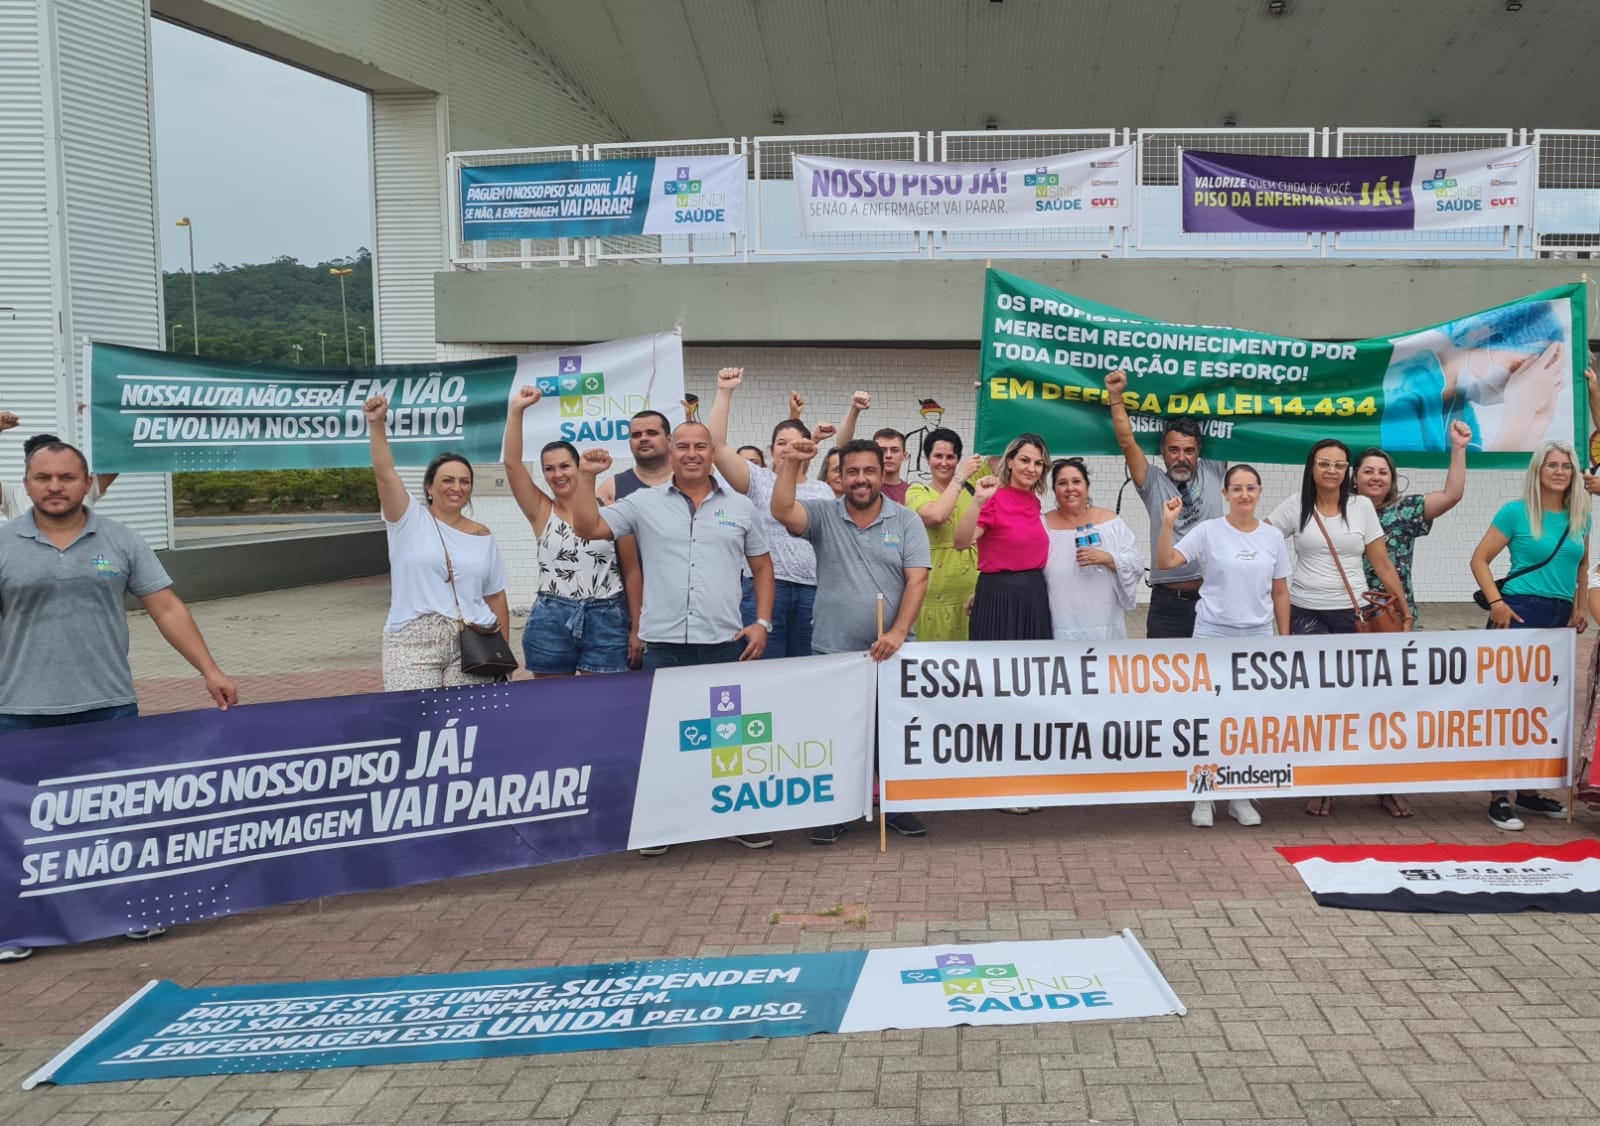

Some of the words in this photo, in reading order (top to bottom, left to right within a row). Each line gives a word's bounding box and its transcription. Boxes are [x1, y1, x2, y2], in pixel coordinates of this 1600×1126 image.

[467, 185, 507, 201] PAGUEM
[506, 186, 513, 200] O
[514, 184, 544, 200] NOSSO
[544, 184, 565, 199] PISO
[567, 181, 611, 197] SALARIAL
[613, 171, 638, 196] JÁ!
[811, 168, 896, 198] NOSSO
[903, 173, 963, 197] PISO
[968, 167, 1007, 195] JÁ!
[1195, 176, 1247, 189] VALORIZE
[1249, 179, 1276, 191] QUEM
[1278, 181, 1307, 193] CUIDA
[1310, 182, 1322, 194] DE
[1359, 175, 1402, 207] JÁ!
[464, 207, 474, 219] SE
[495, 207, 502, 218] A
[502, 205, 559, 219] ENFERMAGEM
[560, 199, 582, 217] VAI
[583, 197, 634, 216] PARAR!
[689, 192, 726, 207] SINDI
[851, 202, 858, 216] A
[862, 201, 940, 217] ENFERMAGEM
[943, 201, 962, 215] VAI
[965, 199, 1008, 214] PARAR.
[1036, 196, 1082, 212] SAÚDE
[1194, 191, 1228, 207] PISO
[1231, 191, 1252, 207] DA
[1255, 191, 1355, 207] ENFERMAGEM
[1436, 198, 1482, 211] SAÚDE
[675, 207, 726, 224] SAÚDE
[996, 293, 1026, 312] OS
[994, 317, 1098, 345] MERECEM
[1103, 329, 1307, 359] RECONHECIMENTO
[1311, 343, 1357, 361] POR
[992, 342, 1050, 364] TODA
[1054, 348, 1179, 378] DEDICAÇÃO
[1183, 359, 1196, 376] E
[1200, 361, 1308, 383] ESFORÇO!
[120, 384, 193, 407] NOSSA
[191, 385, 243, 407] LUTA
[244, 384, 292, 408] NÃO
[289, 384, 346, 408] SERÁ
[346, 378, 398, 407] EM
[402, 371, 468, 405] VÃO.
[990, 377, 1034, 400] EM
[1167, 393, 1211, 415] DA
[1216, 392, 1262, 416] LEI
[1269, 395, 1377, 418] 14.434
[132, 416, 263, 441] DEVOLVAM
[264, 416, 339, 439] NOSSO
[560, 417, 632, 443] SAÚD
[900, 657, 984, 698] ESSA
[993, 655, 1072, 697] LUTA
[1080, 648, 1099, 695] É
[1108, 652, 1221, 697] NOSSA,
[1231, 650, 1309, 691] ESSA
[1319, 648, 1392, 689] LUTA
[1402, 640, 1419, 686] É
[1429, 646, 1467, 686] DO
[1477, 644, 1559, 687] POVO,
[904, 717, 922, 765] É
[933, 722, 1003, 765] COM
[1014, 722, 1092, 761] LUTA
[1102, 719, 1163, 761] QUE
[1172, 718, 1210, 757] SE
[1219, 713, 1360, 756] GARANTE
[1369, 711, 1407, 751] OS
[1416, 706, 1558, 750] DIREITOS.
[746, 738, 833, 775] SINDI
[29, 770, 217, 832] QUEREMOS
[220, 758, 327, 804] NOSSO
[328, 749, 400, 790] PISO
[405, 718, 478, 780] JÁ!
[1216, 763, 1292, 788] Sindserpi
[711, 773, 835, 814] SAÚDE
[20, 851, 59, 886] SE
[64, 838, 133, 880] NÃO
[137, 838, 160, 869] A
[166, 808, 363, 865] ENFERMAGEM
[370, 783, 438, 833] VAI
[443, 765, 592, 823] PARAR!
[176, 1000, 326, 1021] PATRÕES
[322, 998, 349, 1013] E
[344, 995, 403, 1012] STF
[400, 993, 445, 1008] SE
[443, 988, 534, 1004] UNEM
[532, 985, 557, 999] E
[553, 967, 801, 998] SUSPENDEM
[988, 974, 1104, 994] SINDI
[153, 1019, 243, 1038] PISO
[238, 1009, 395, 1032] SALARIAL
[400, 1005, 451, 1022] DA
[451, 990, 671, 1018] ENFERMAGEM.
[947, 991, 1113, 1013] SAÚDE
[113, 1042, 150, 1060] A
[148, 1030, 398, 1058] ENFERMAGEM
[396, 1020, 485, 1042] ESTÁ
[485, 1008, 635, 1037] UNIDA
[640, 1007, 724, 1026] PELO
[726, 1002, 807, 1019] PISO.
